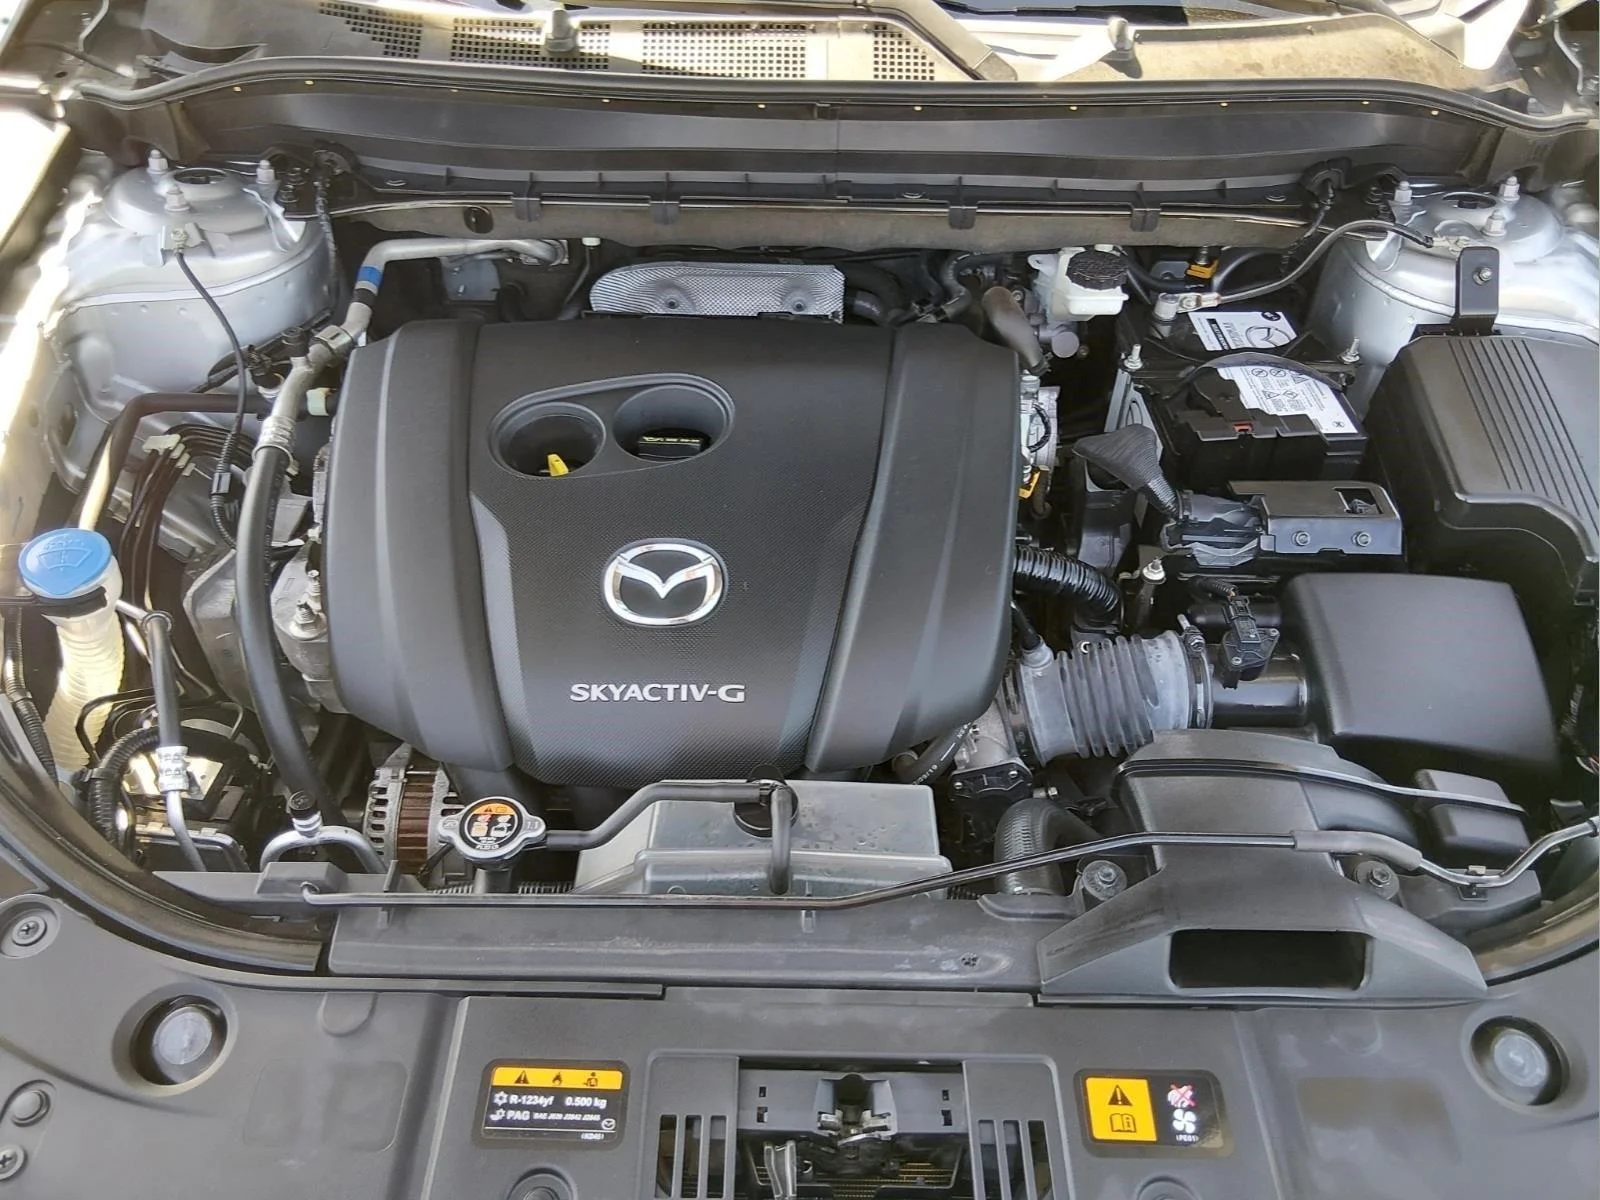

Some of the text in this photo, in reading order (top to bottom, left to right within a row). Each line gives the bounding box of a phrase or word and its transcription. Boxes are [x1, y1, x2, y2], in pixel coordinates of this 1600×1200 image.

[570, 683, 745, 702] SKYACTIV-G
[509, 1094, 607, 1109] R-1234yf 0.500 kg
[507, 1110, 530, 1121] PAG
